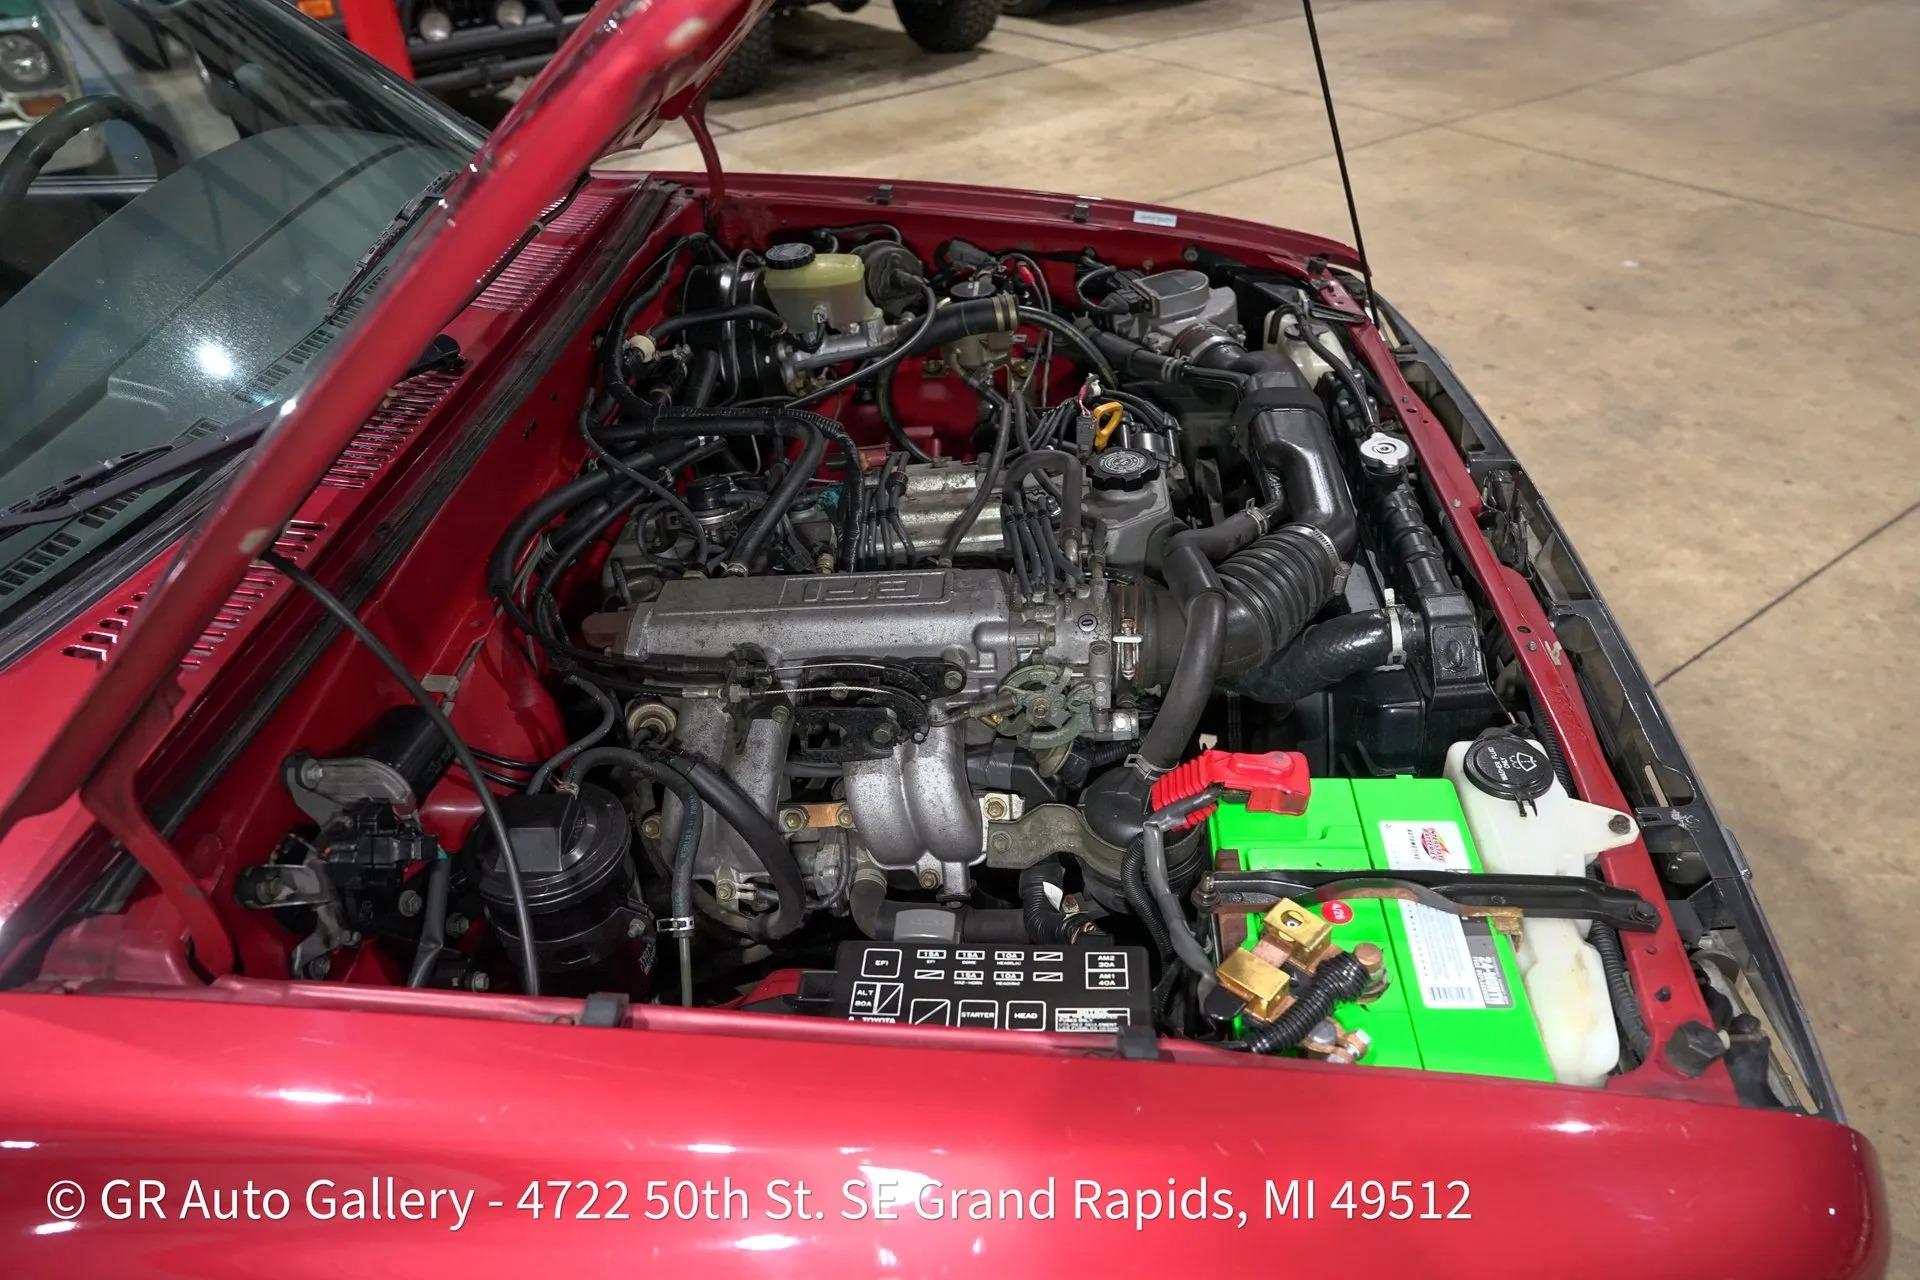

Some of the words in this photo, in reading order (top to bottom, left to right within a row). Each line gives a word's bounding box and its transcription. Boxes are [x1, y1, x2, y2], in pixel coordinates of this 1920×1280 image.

[1487, 746, 1499, 760] FLUID
[1499, 757, 1511, 769] ONLY
[1494, 761, 1508, 781] WASHER
[862, 1016, 896, 1024] TOYOTA
